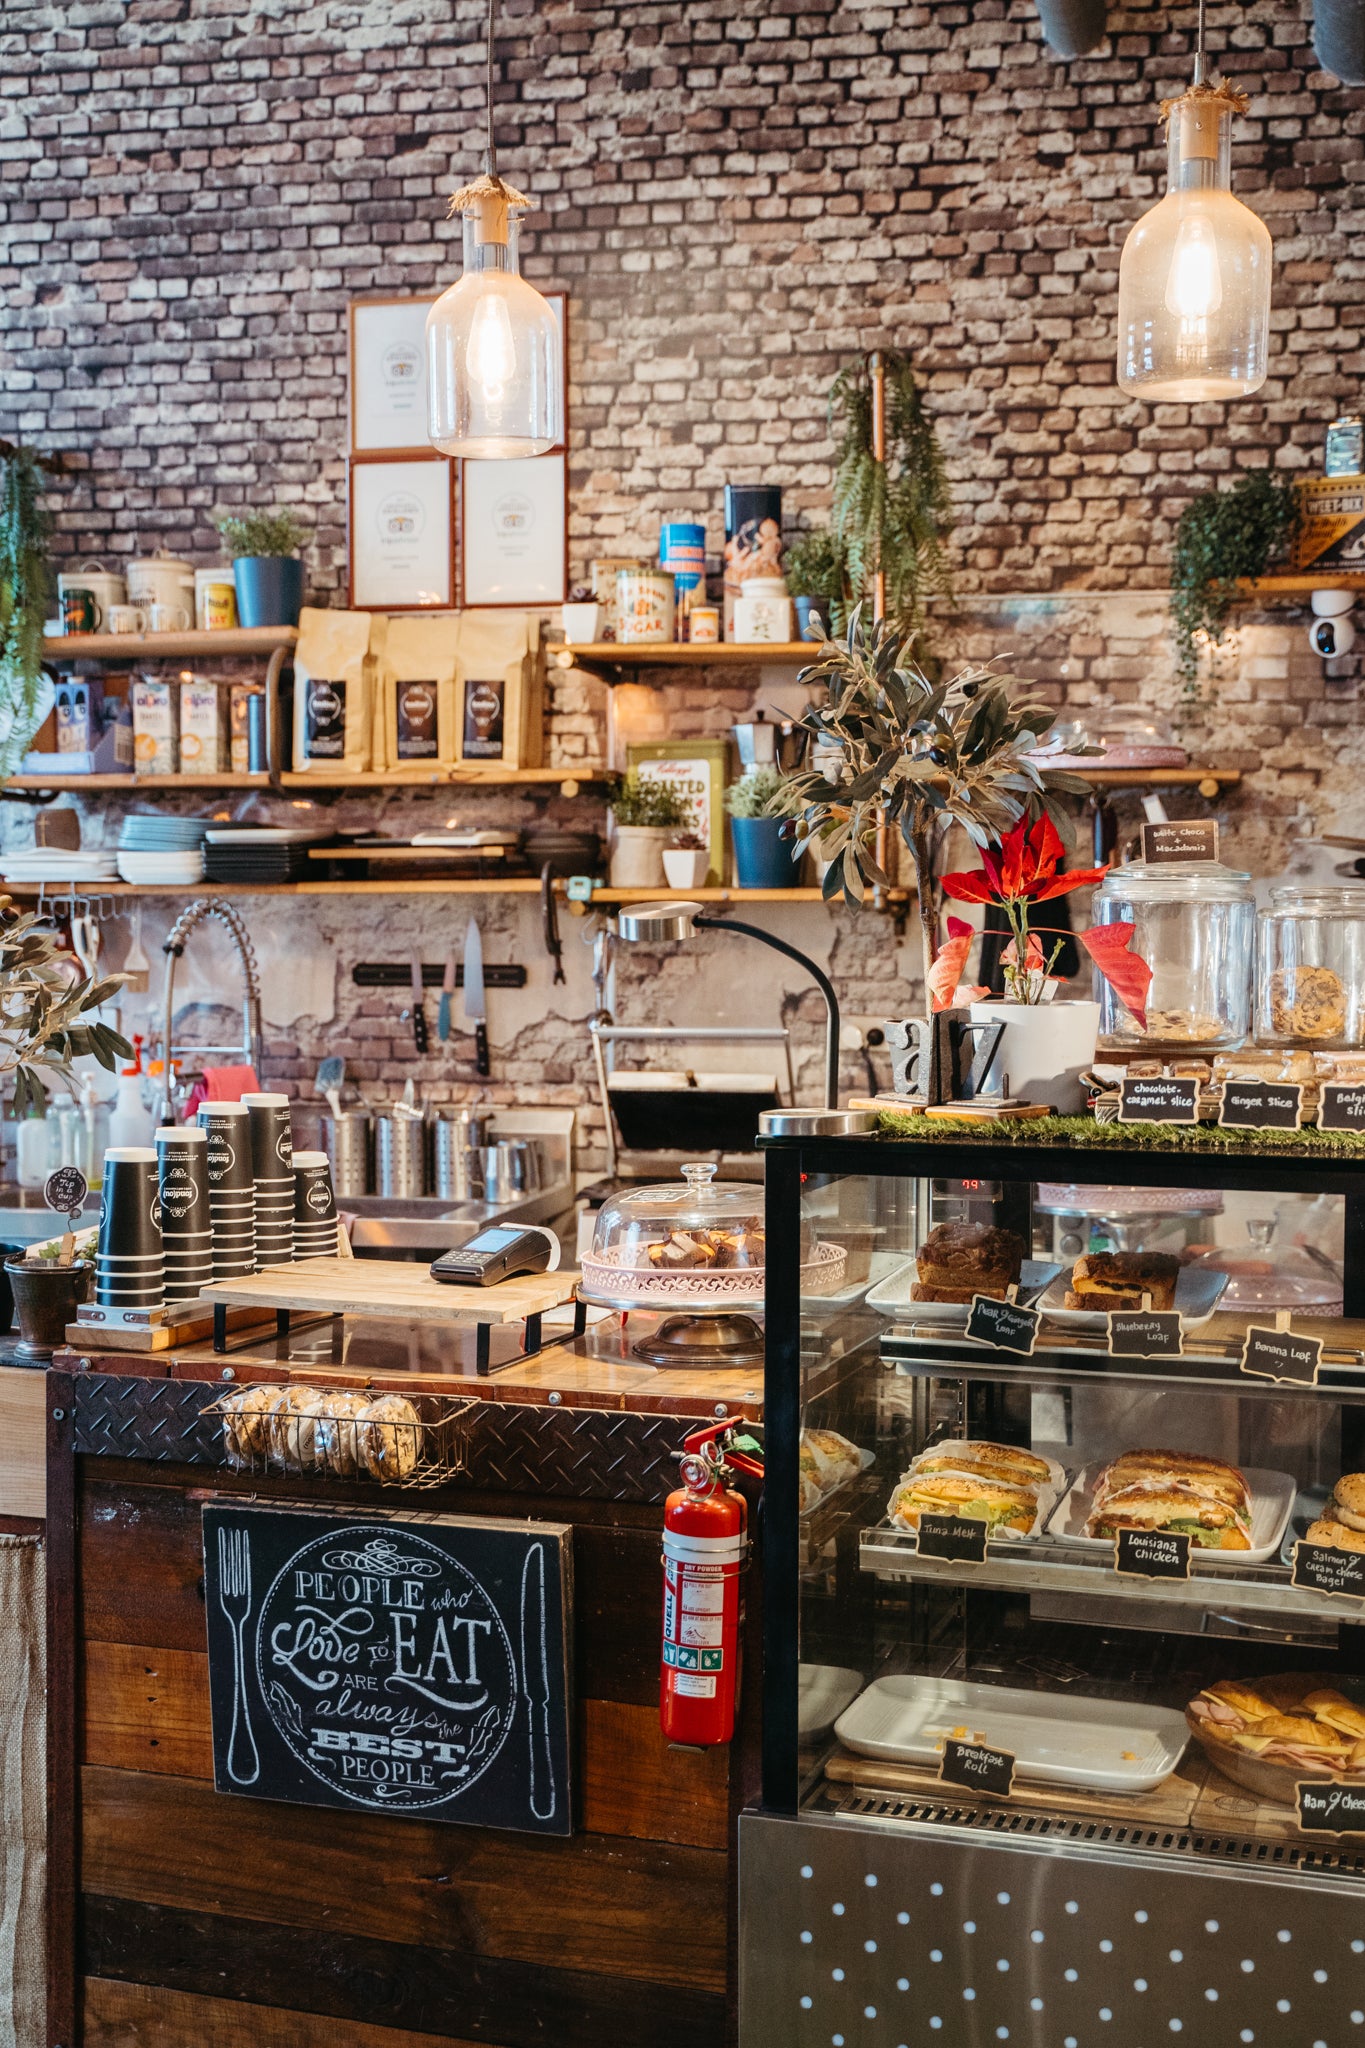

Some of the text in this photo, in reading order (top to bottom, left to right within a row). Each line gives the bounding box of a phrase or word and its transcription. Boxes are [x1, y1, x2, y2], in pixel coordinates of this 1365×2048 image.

[1307, 498, 1362, 515] WEET-BIX
[1180, 828, 1205, 836] Choco
[1156, 843, 1206, 852] Macadamia
[1170, 1095, 1193, 1106] slice
[1255, 1341, 1288, 1357] Banana
[1128, 1533, 1177, 1554] Louisiana
[1312, 1550, 1347, 1566] Salmon
[1315, 1573, 1344, 1587] Bagel
[294, 1570, 473, 1611] PEOPLE who
[665, 1594, 673, 1638] QUELL
[271, 1605, 374, 1691] Love
[387, 1611, 491, 1690] EAT
[342, 1673, 379, 1691] ARE
[315, 1690, 464, 1740] always the
[310, 1727, 465, 1764] BEST
[956, 1745, 1004, 1766] Breakfast
[341, 1755, 436, 1786] PEOPLE
[964, 1759, 989, 1774] Roll
[1303, 1793, 1327, 1809] Ham
